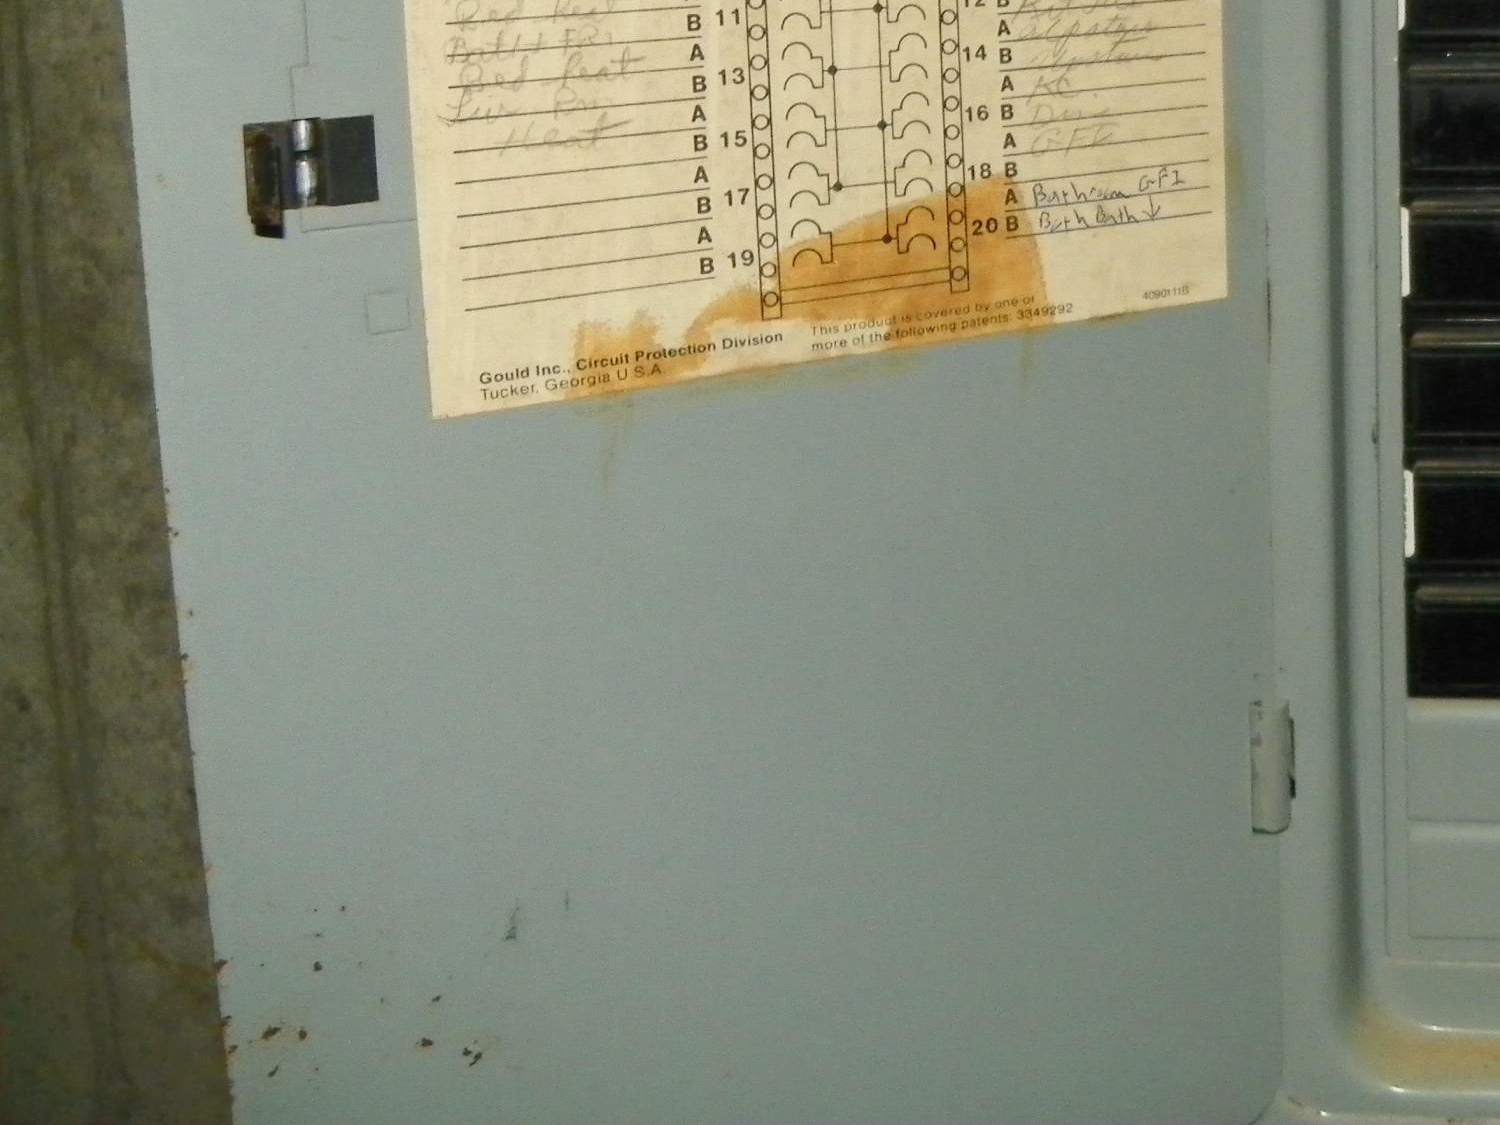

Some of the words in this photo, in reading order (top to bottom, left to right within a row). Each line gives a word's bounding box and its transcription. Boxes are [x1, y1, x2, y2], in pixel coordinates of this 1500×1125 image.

[687, 14, 701, 31] B
[716, 8, 739, 26] 11
[998, 20, 1010, 36] A
[690, 44, 704, 61] A
[963, 45, 986, 62] 14
[1000, 48, 1012, 64] B
[692, 75, 706, 93] B
[718, 68, 745, 85] 13
[1001, 75, 1014, 92] A
[692, 105, 706, 122] A
[966, 105, 989, 122] 16
[1001, 104, 1013, 120] B
[694, 134, 708, 152] B
[720, 130, 747, 147] 15
[1004, 133, 1016, 149] A
[694, 166, 708, 183] A
[968, 163, 991, 180] 18
[1005, 162, 1017, 179] B
[725, 188, 749, 206] 17
[1005, 188, 1018, 205] A
[697, 197, 711, 214] B
[972, 217, 998, 235] 20
[1006, 216, 1019, 232] B
[698, 226, 712, 244] A
[700, 258, 714, 274] B
[728, 250, 754, 268] 19
[811, 337, 847, 351] more
[851, 333, 865, 347] of
[869, 328, 891, 344] the
[895, 320, 957, 342] following
[1017, 303, 1073, 320] 3349292
[480, 367, 529, 384] Gould
[576, 354, 629, 372] Circuit
[635, 343, 716, 362] Protection
[722, 334, 782, 349] Division
[545, 371, 610, 392] Georgia
